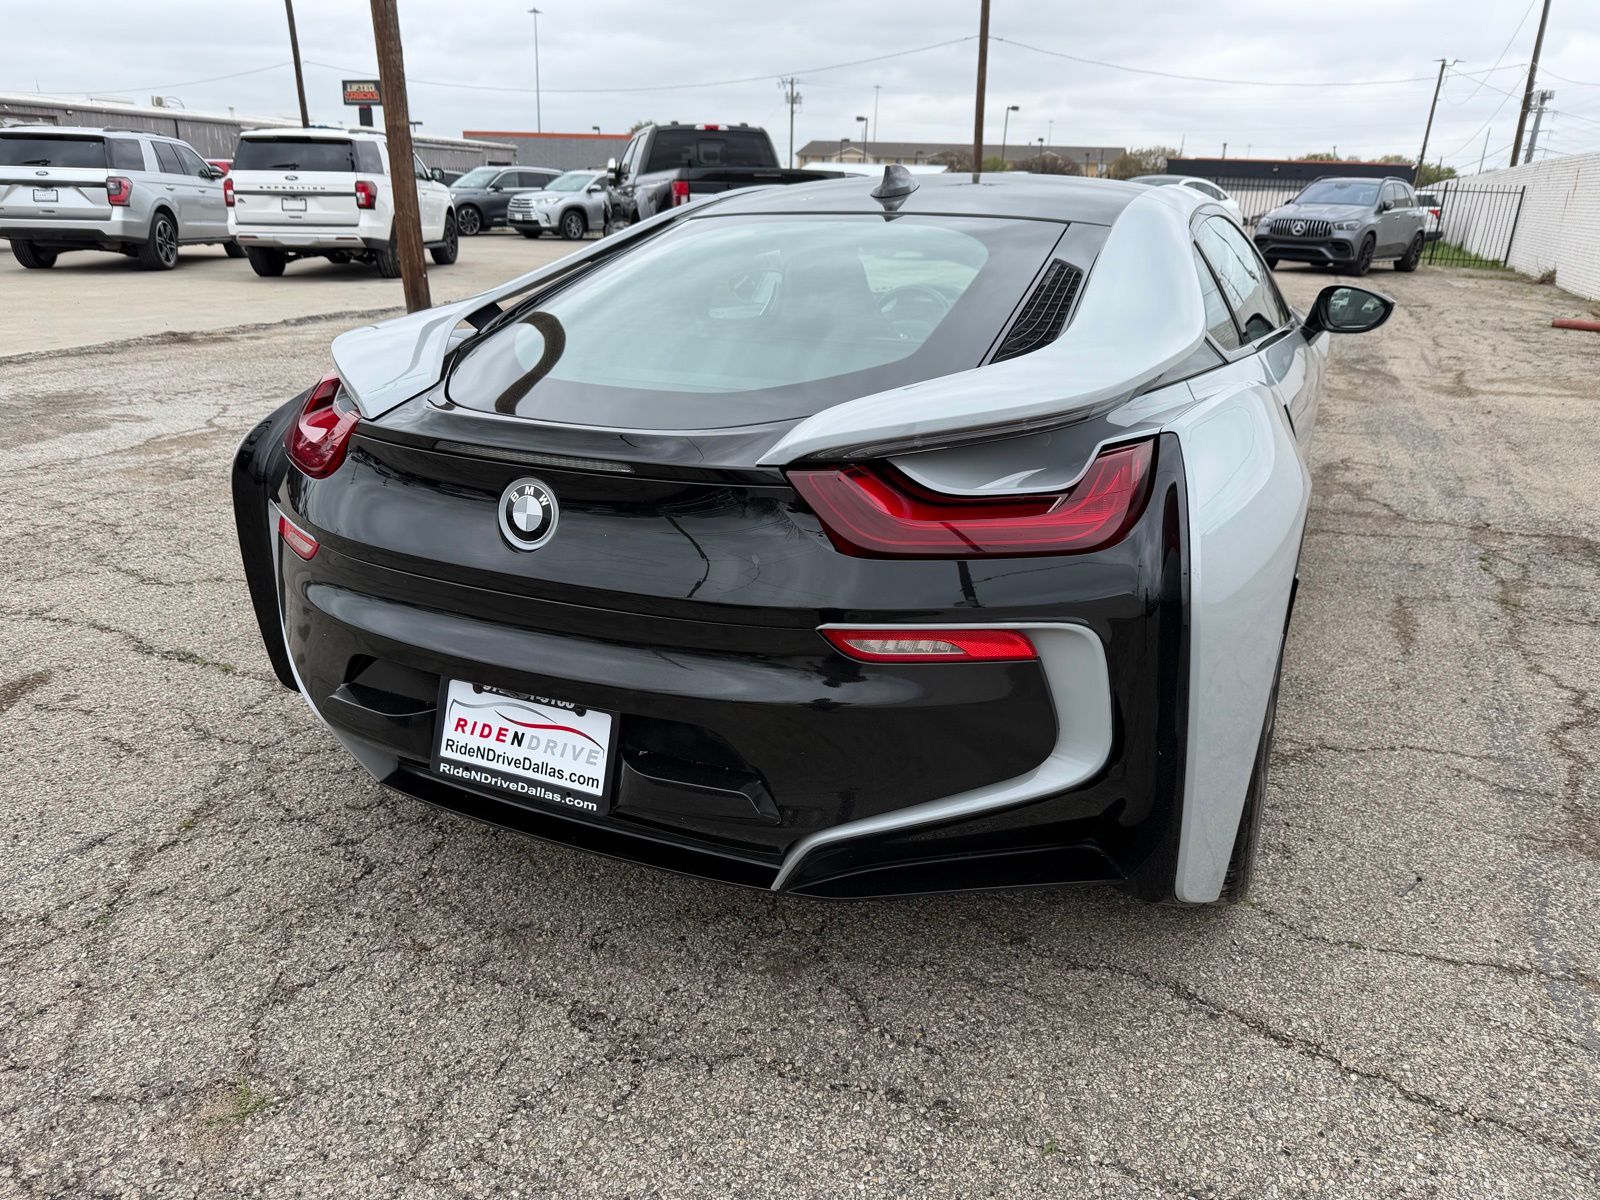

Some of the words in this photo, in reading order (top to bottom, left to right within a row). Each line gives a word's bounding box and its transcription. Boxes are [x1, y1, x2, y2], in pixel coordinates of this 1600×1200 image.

[510, 486, 550, 506] BMW
[445, 738, 600, 789] RideNDriveDallas.com
[454, 717, 601, 766] RIDENDRIVE
[439, 762, 598, 811] RideNDriveDallas.com
